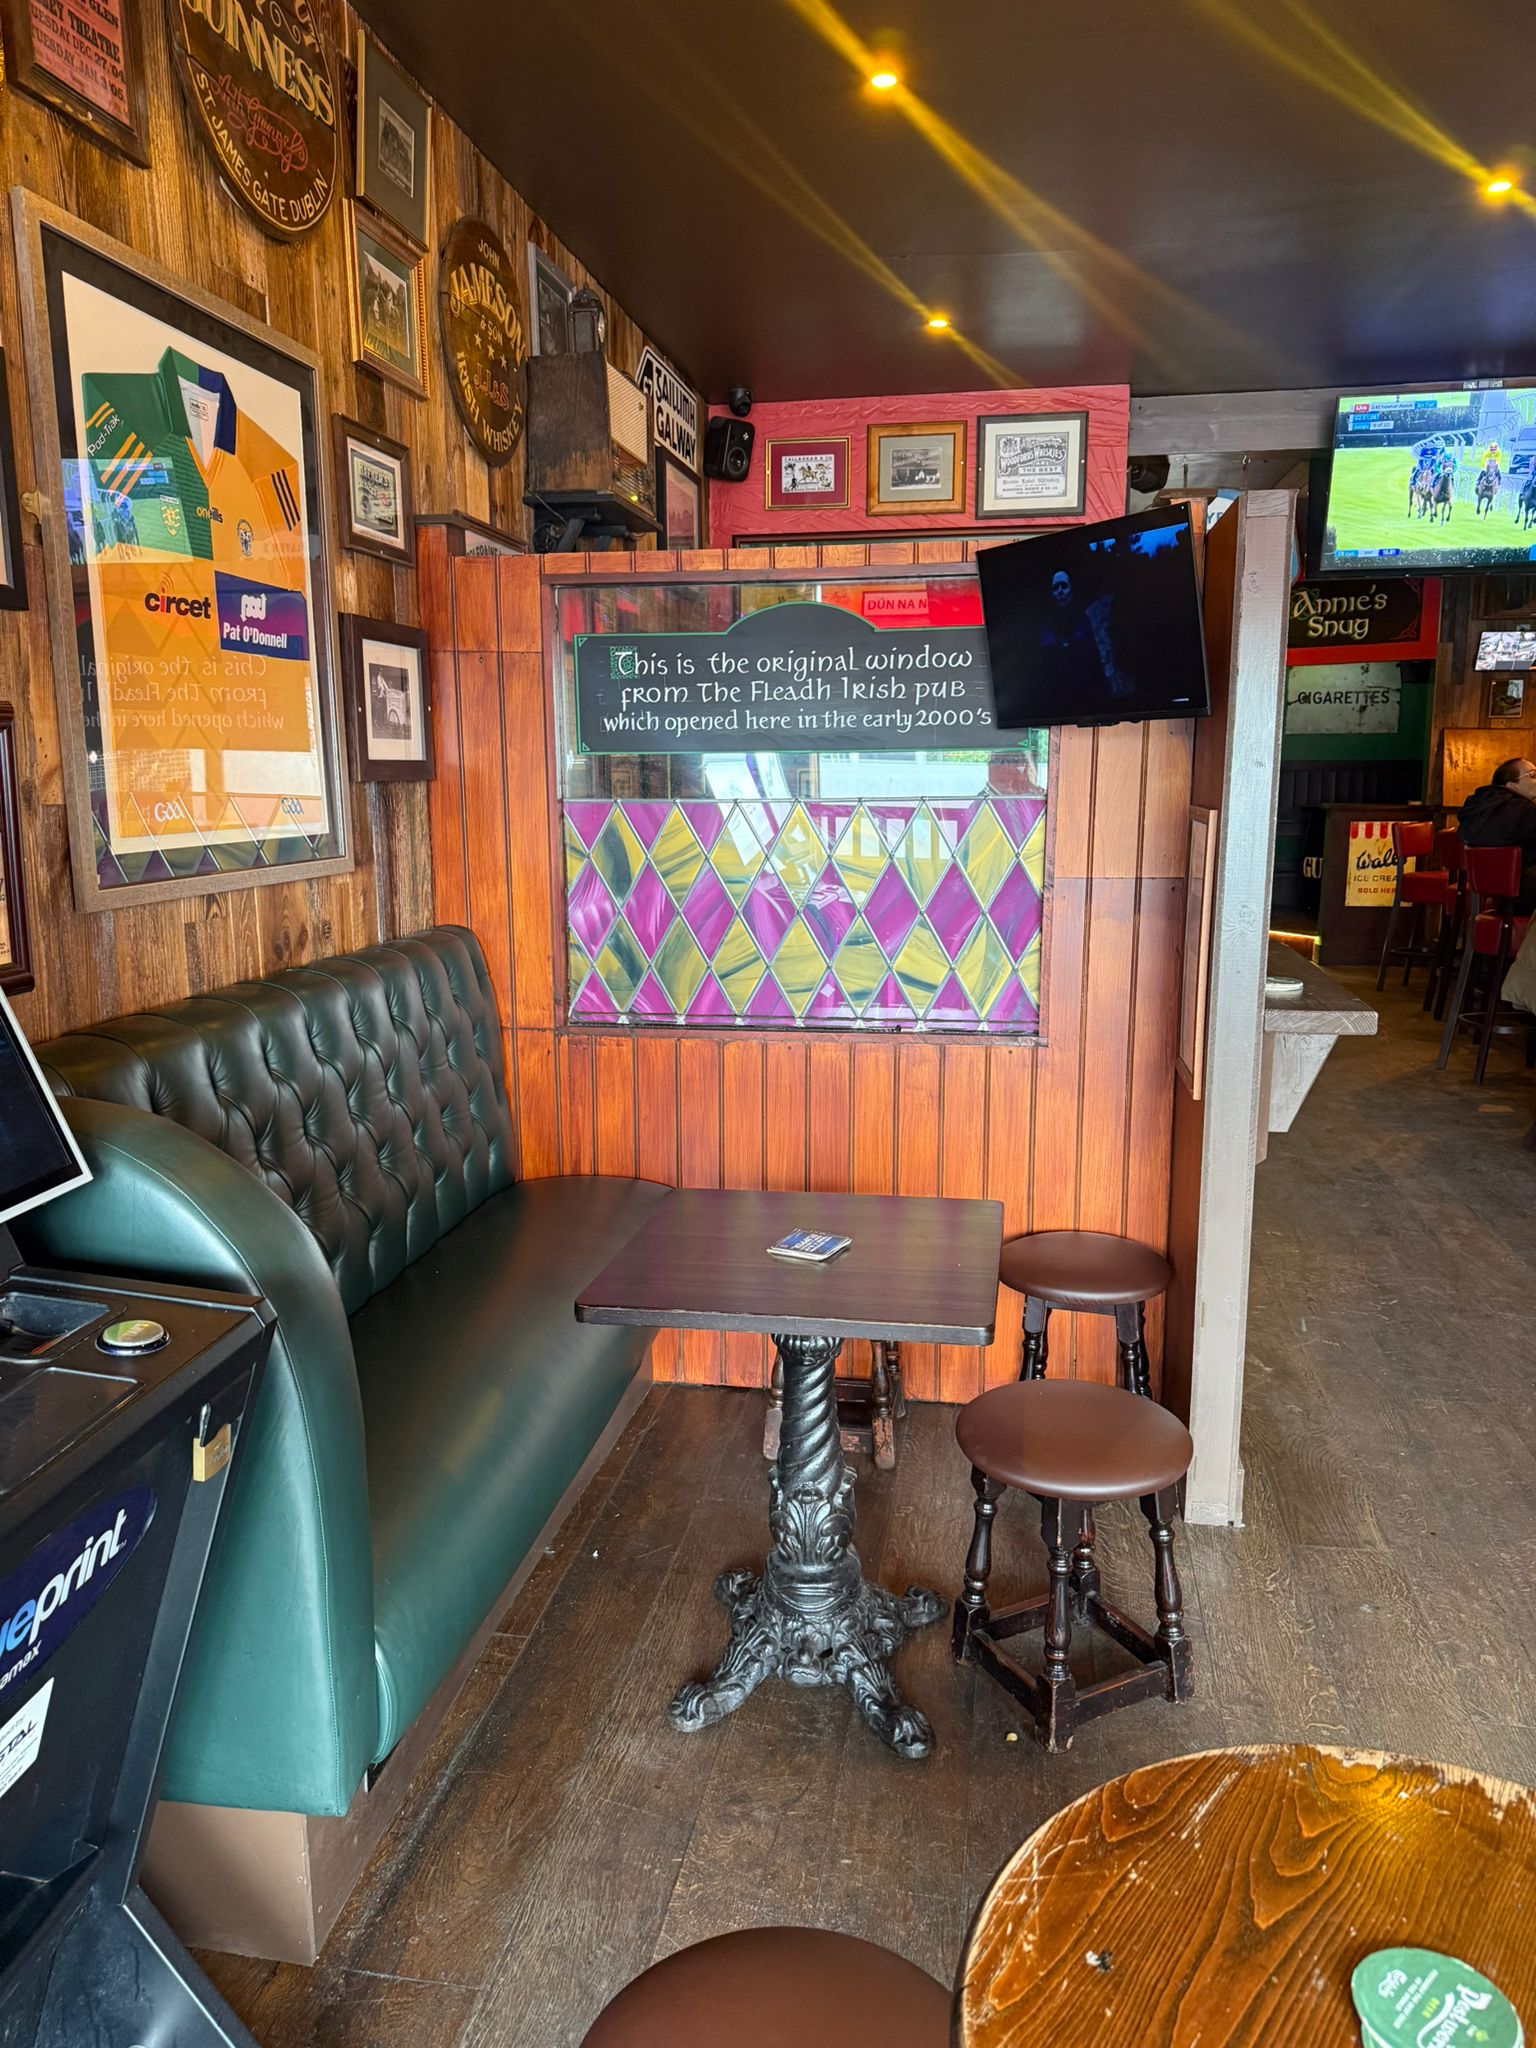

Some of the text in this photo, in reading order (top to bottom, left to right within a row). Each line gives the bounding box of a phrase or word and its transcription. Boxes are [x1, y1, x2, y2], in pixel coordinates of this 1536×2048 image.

[31, 6, 71, 44] UESDAY
[67, 9, 120, 63] THEATRE
[212, 115, 251, 187] JAMES
[253, 180, 288, 221] GATE
[290, 169, 328, 222] DUBLIN
[478, 238, 500, 271] JOHN
[450, 262, 526, 367] JAMESON
[456, 351, 523, 453] IRISH WHISKEY
[87, 414, 121, 457] Pod-Trak
[656, 404, 696, 467] GALWAY
[144, 587, 211, 619] circet
[867, 597, 928, 610] DÚN NA N
[1293, 584, 1388, 618] Annie's
[223, 622, 288, 649] Pat O'Donnell
[1307, 616, 1369, 639] Snug
[615, 644, 973, 682] This is the original window
[696, 682, 742, 703] The
[751, 678, 831, 702] Fleadh
[1297, 690, 1390, 704] CIGARETTES
[603, 708, 992, 738] which opened here in the early 2000's
[1303, 857, 1323, 879] GU
[1372, 874, 1399, 882] CREA
[0, 1640, 43, 1689] amax
